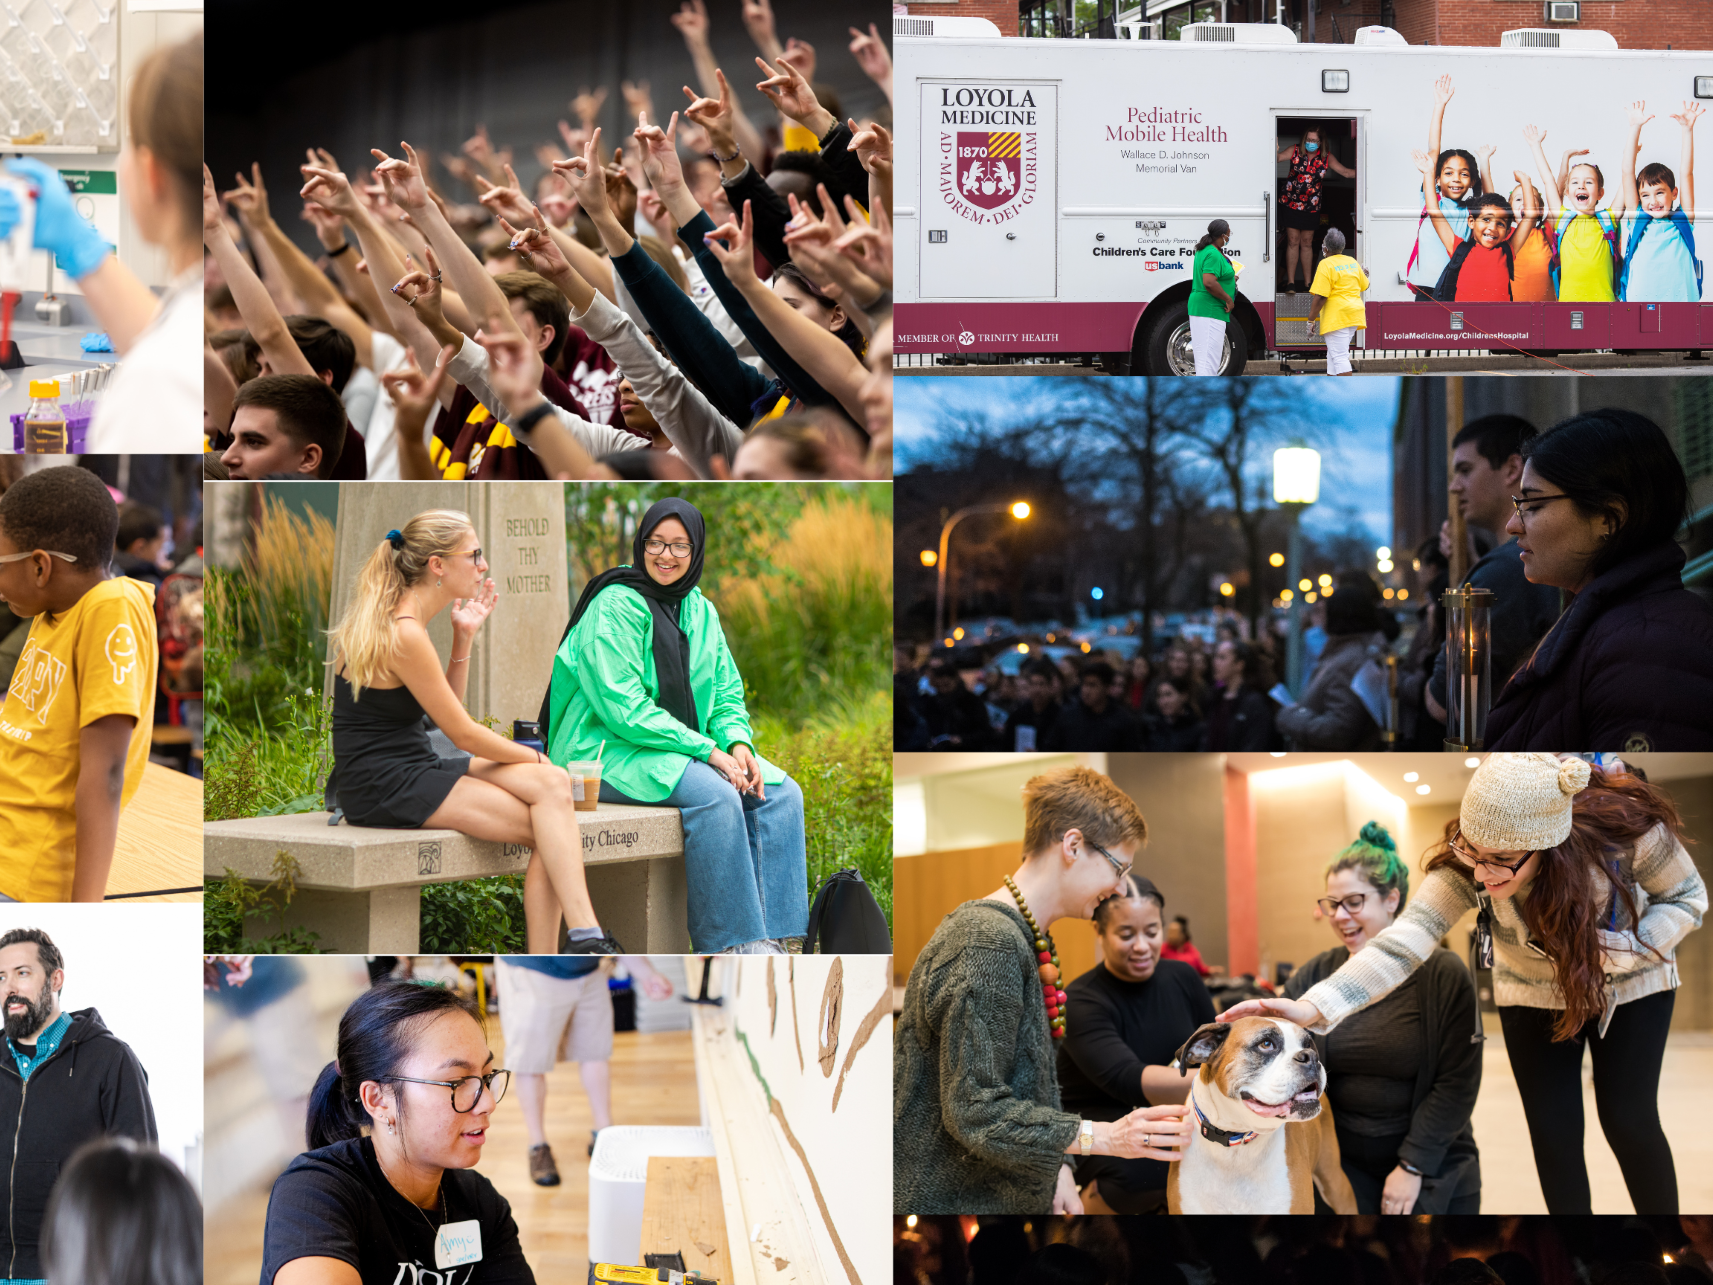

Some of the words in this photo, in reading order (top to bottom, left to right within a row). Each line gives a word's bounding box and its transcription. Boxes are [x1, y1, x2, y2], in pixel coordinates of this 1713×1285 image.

[942, 88, 1037, 107] LOYOLA
[942, 110, 1037, 125] MEDICINE
[1127, 107, 1202, 124] Pediatric
[941, 131, 952, 153] AD
[1106, 125, 1166, 142] Mobile
[1172, 126, 1228, 143] Health
[958, 146, 988, 158] 1870
[1120, 150, 1156, 160] Wallace
[1159, 150, 1169, 160] D.
[1171, 150, 1210, 160] Johnson
[1021, 132, 1037, 204] GLORIAM
[1136, 164, 1178, 173] Memorial
[1180, 165, 1197, 173] Van
[940, 162, 985, 225] MAJOREM
[993, 204, 1020, 225] DEI
[1137, 237, 1171, 245] Community
[1093, 247, 1146, 257] Children's
[1150, 247, 1175, 256] Care
[898, 334, 939, 343] MEMBER
[941, 334, 955, 342] OF
[978, 333, 1019, 342] TRINITY
[1022, 333, 1059, 342] HEALTH
[1384, 332, 1529, 340] LoyolaMedicine.org/ChildrensHospital
[506, 518, 549, 537] BEHOLD
[517, 547, 538, 565] THY
[506, 574, 551, 594] MOTHER
[598, 830, 639, 847] Chicago
[440, 1234, 466, 1254] Amy
